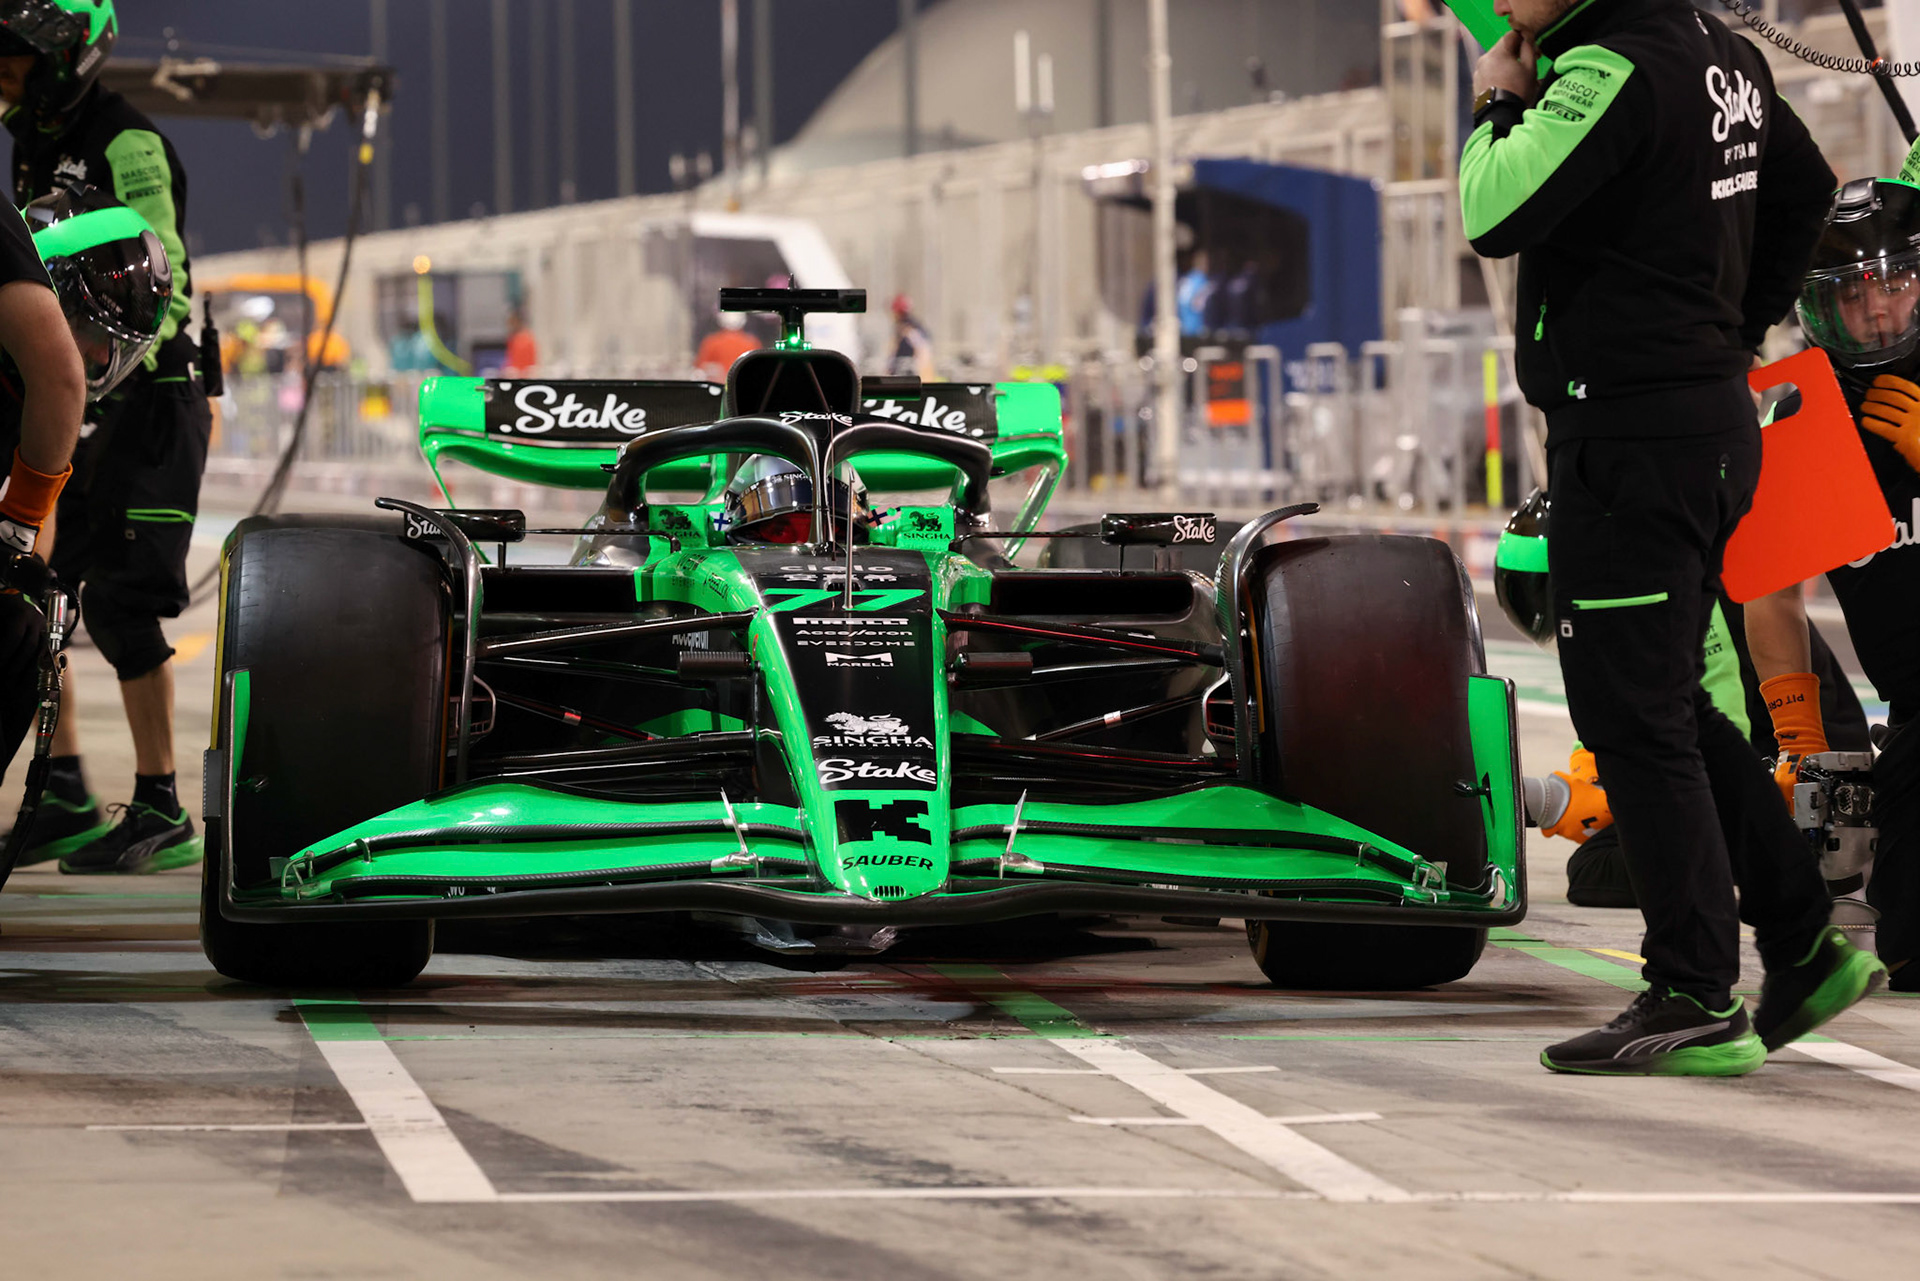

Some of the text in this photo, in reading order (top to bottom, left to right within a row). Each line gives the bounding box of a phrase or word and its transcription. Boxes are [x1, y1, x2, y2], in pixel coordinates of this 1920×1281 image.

[1557, 79, 1600, 100] MASCOT
[1705, 65, 1763, 143] Stake
[513, 384, 647, 435] Stake
[780, 411, 853, 427] Stake
[863, 397, 967, 434] take
[1172, 515, 1216, 543] Stake
[763, 588, 926, 612] 77
[792, 617, 910, 625] PIRELLI
[1786, 693, 1805, 705] PIT
[813, 735, 934, 747] SINGHA
[818, 758, 937, 785] Stake
[842, 855, 934, 871] SAUBER
